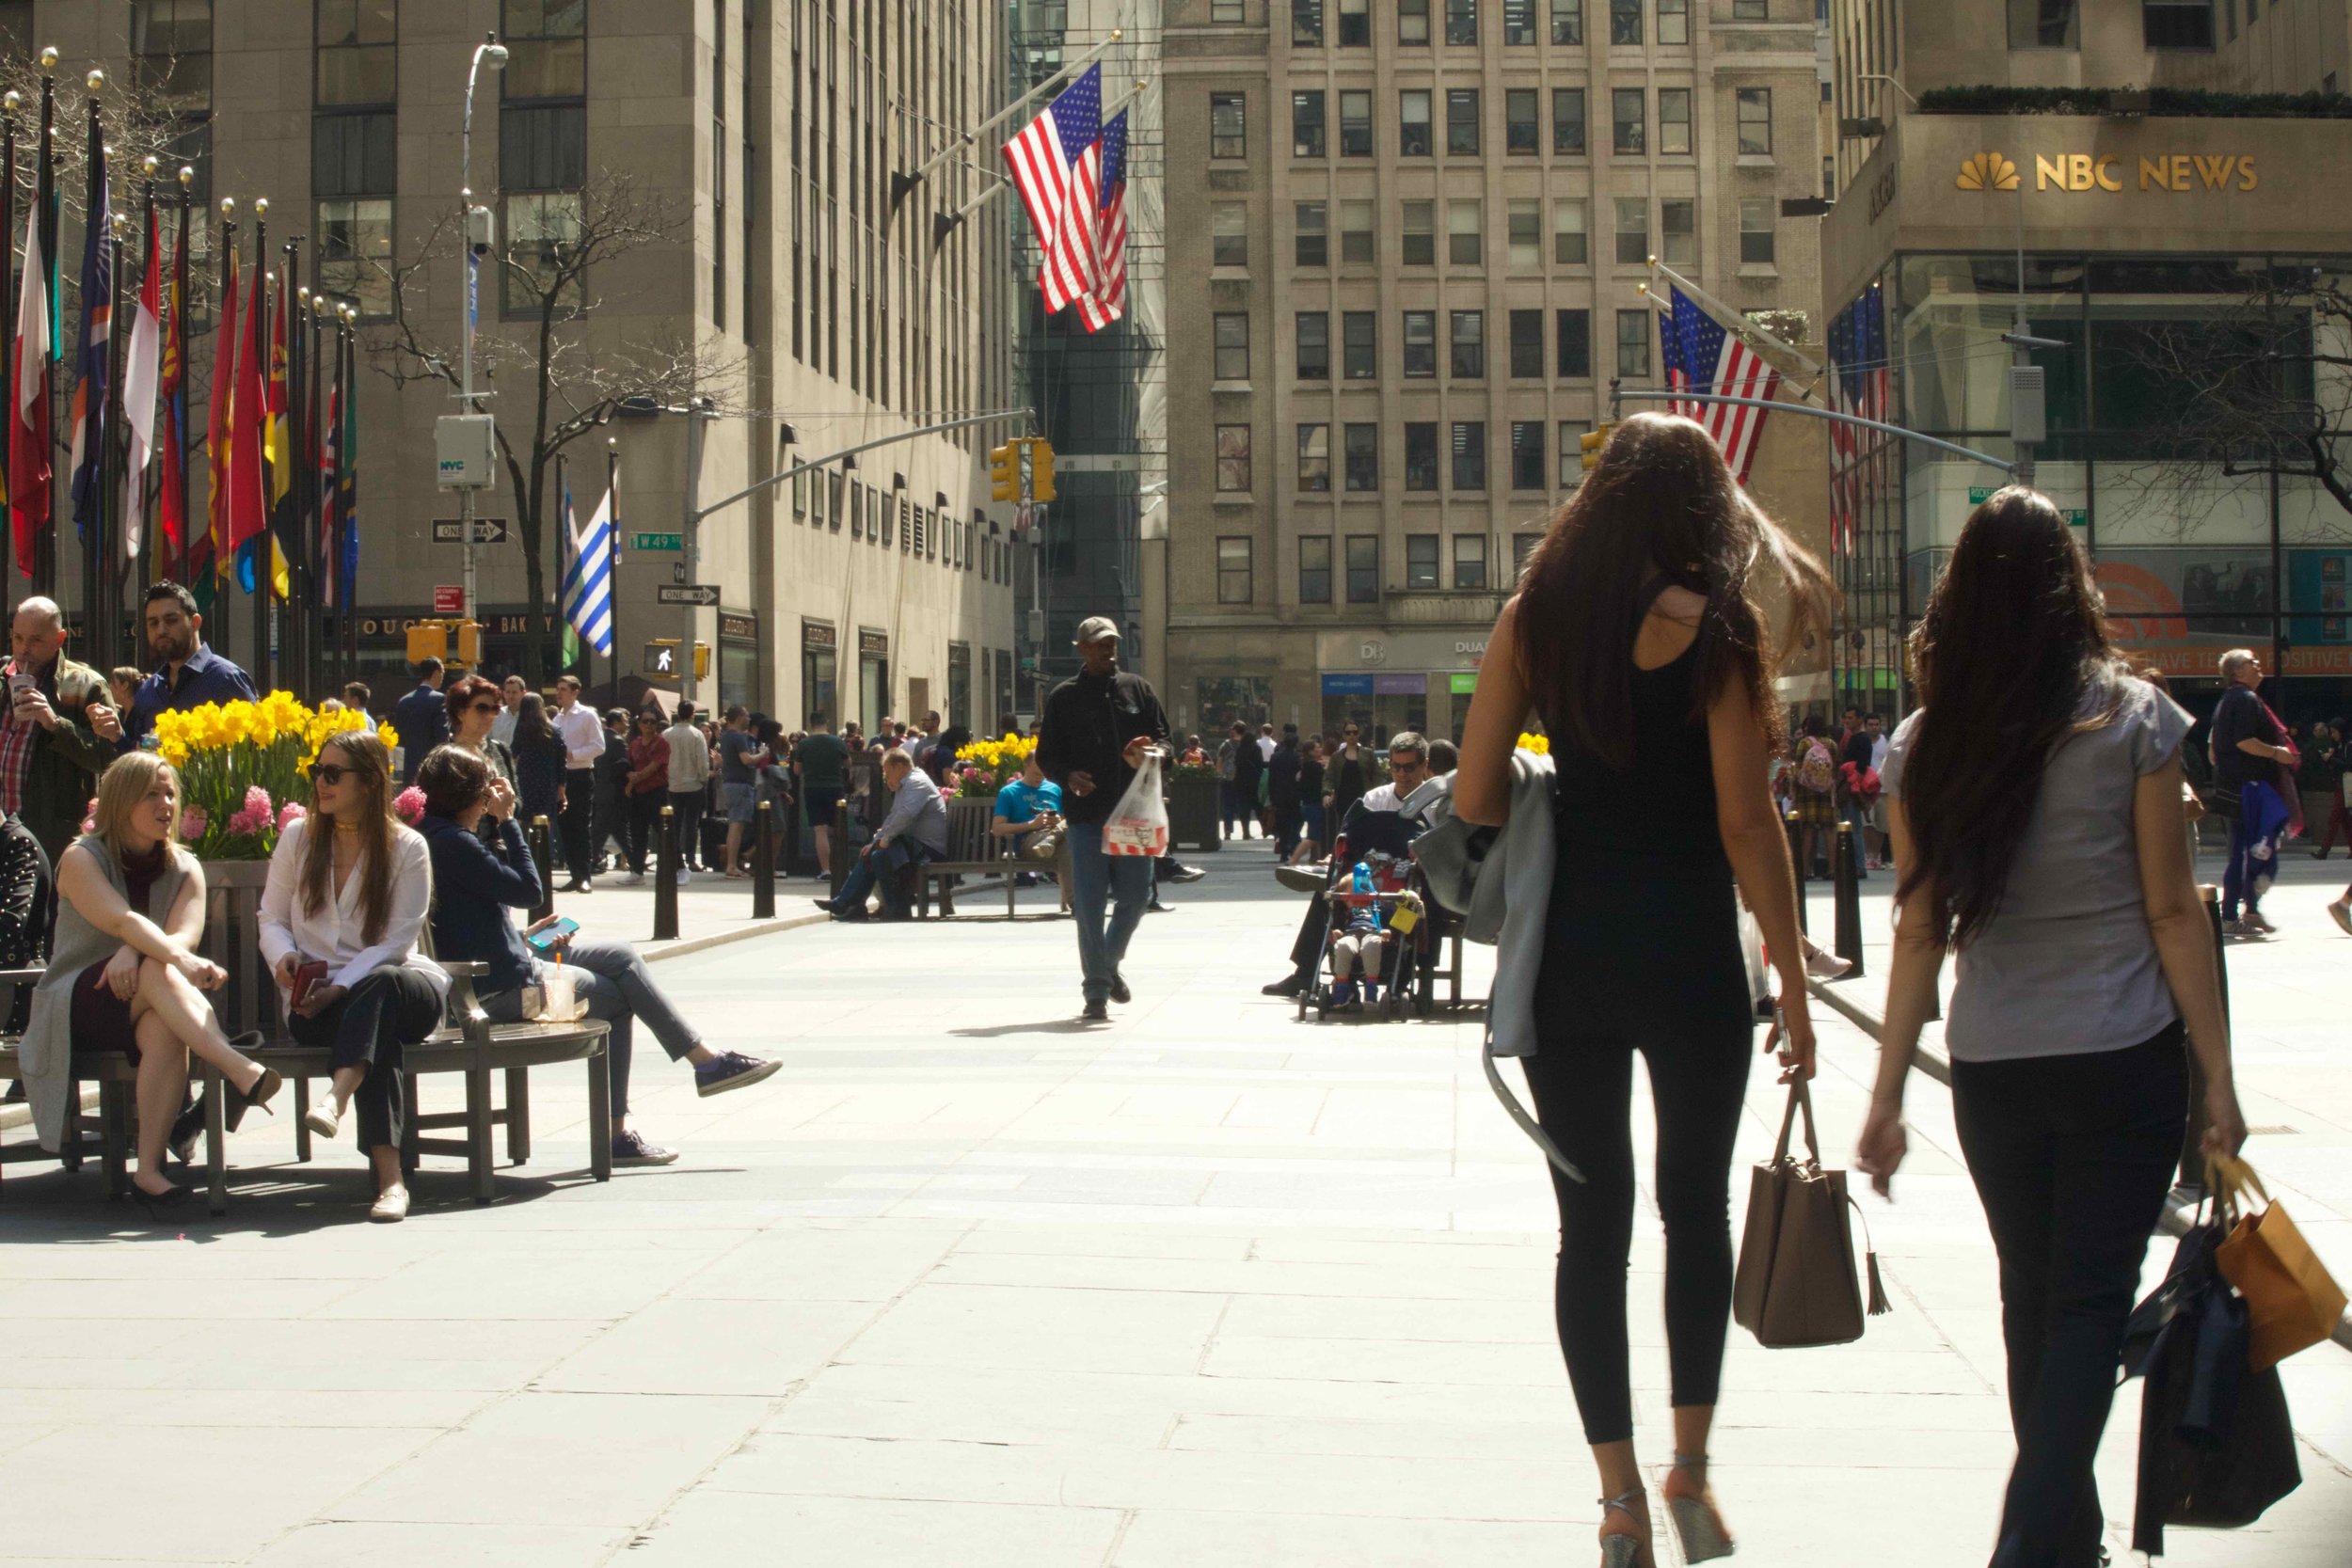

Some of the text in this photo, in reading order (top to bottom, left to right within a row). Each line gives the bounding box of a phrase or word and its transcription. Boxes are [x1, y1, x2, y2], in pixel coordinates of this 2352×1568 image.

[2035, 152, 2258, 192] NBC NEWS
[440, 461, 464, 470] NYC
[442, 526, 464, 536] ONE
[641, 535, 649, 547] W
[653, 535, 668, 547] 49
[666, 591, 711, 599] ONE WAY
[2145, 651, 2191, 669] HAVE
